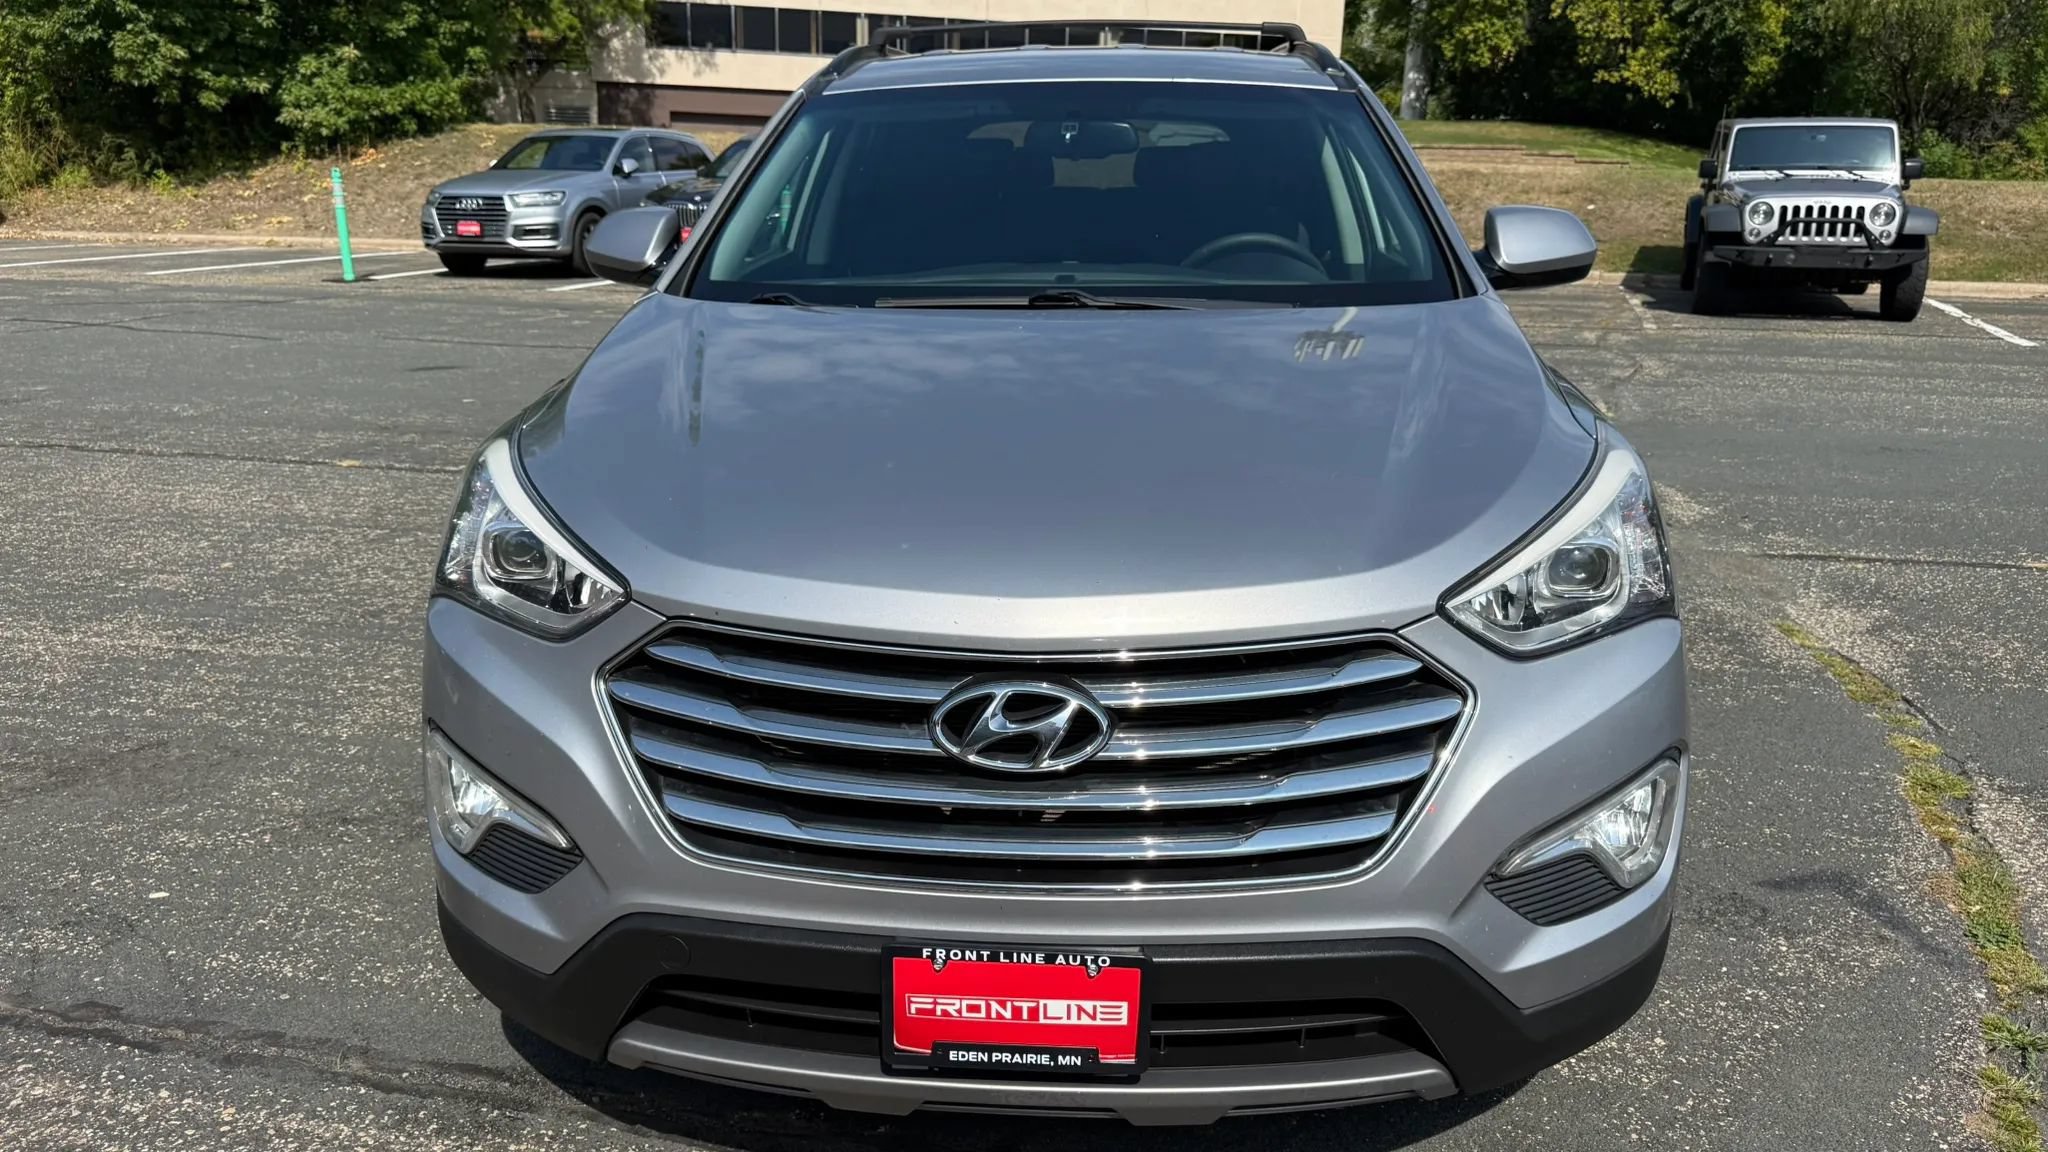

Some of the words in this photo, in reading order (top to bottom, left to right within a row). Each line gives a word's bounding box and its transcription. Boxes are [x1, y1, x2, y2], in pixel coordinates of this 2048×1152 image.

[922, 948, 991, 962] FRONT
[1000, 952, 1046, 964] LINE
[1055, 955, 1111, 967] AUTO
[909, 997, 1123, 1021] FRONTLINE
[949, 1050, 988, 1063] EDEN
[992, 1052, 1054, 1066] PRAIRIE,
[1058, 1056, 1081, 1066] MN
